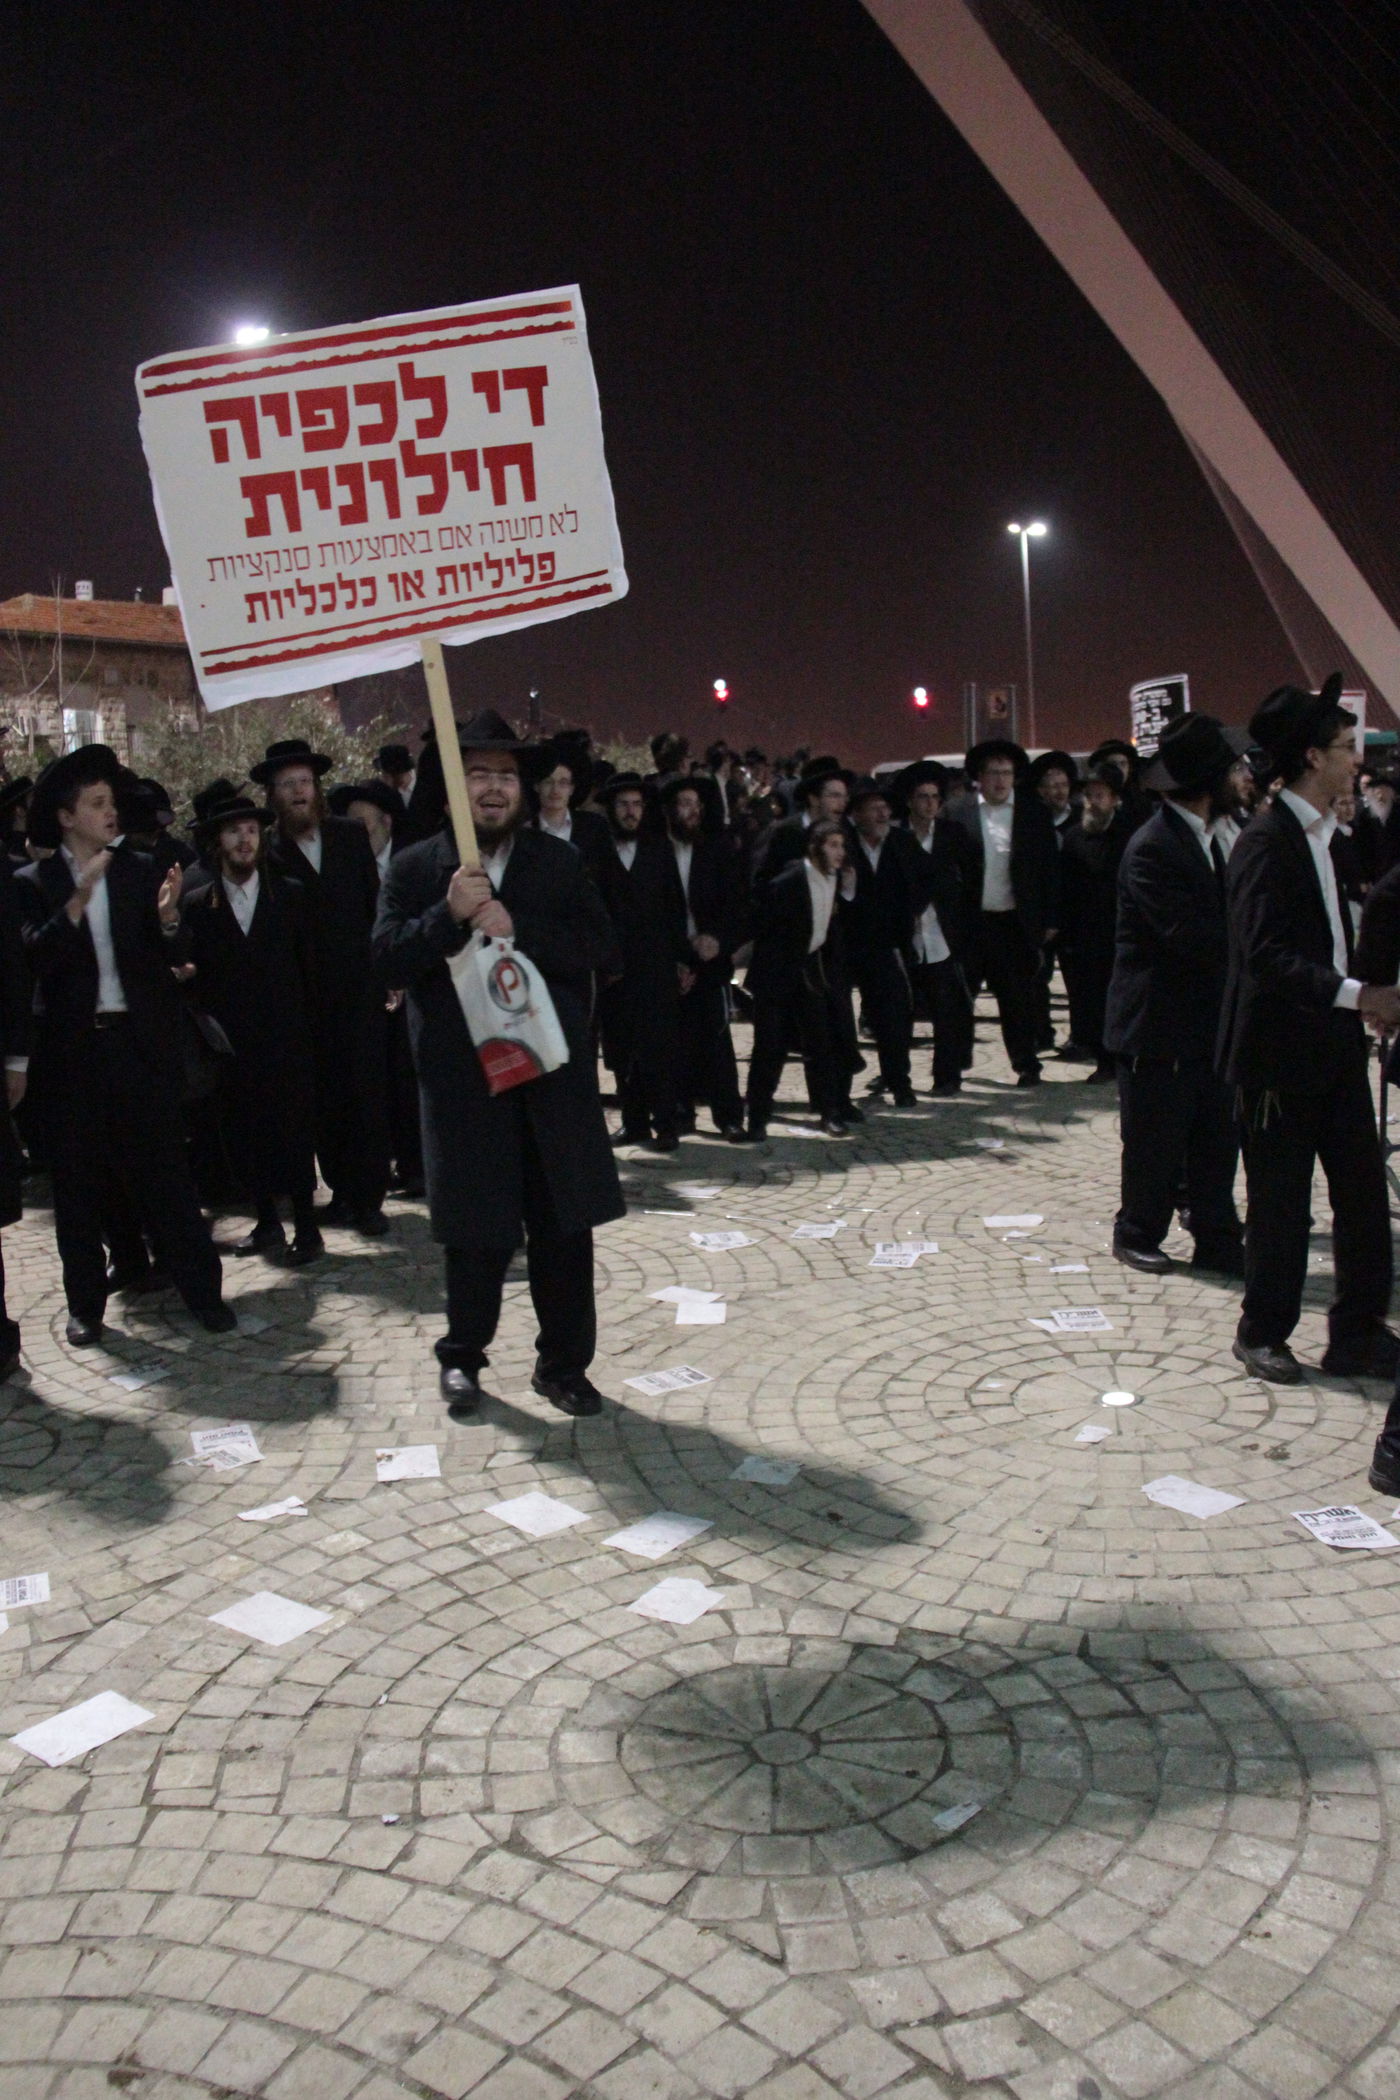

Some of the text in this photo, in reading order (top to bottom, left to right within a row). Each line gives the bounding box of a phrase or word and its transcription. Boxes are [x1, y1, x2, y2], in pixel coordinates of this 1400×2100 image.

[203, 361, 549, 465] די לכפיה
[240, 438, 538, 539] חילונית
[206, 503, 579, 583] לא משנה אם באמצעות סנקציות
[243, 548, 557, 624] פליליות או כלכליות
